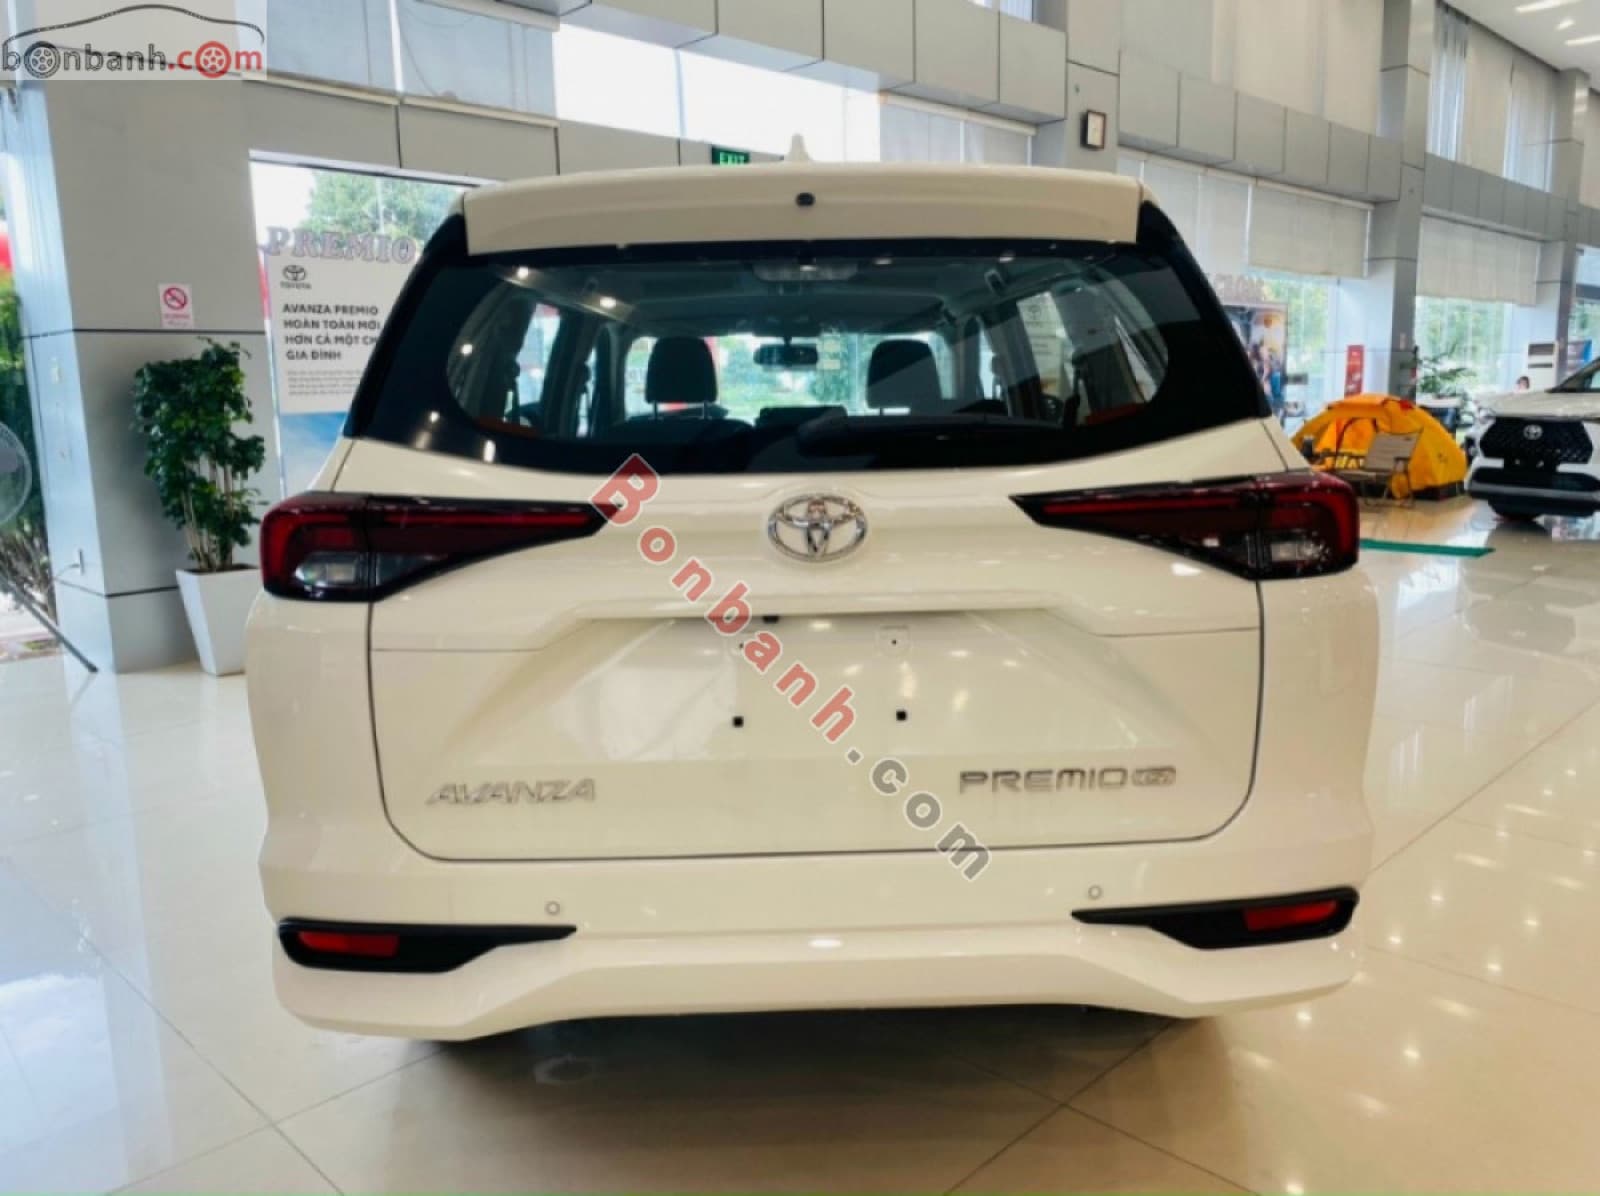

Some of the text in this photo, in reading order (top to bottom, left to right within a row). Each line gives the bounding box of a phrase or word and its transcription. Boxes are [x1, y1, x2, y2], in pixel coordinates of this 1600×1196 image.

[265, 226, 417, 264] PREMIO
[282, 304, 379, 315] AVANZA PREMIO
[286, 351, 309, 361] GIA
[424, 777, 596, 806] AVANZA
[958, 767, 1129, 795] PREMIO
